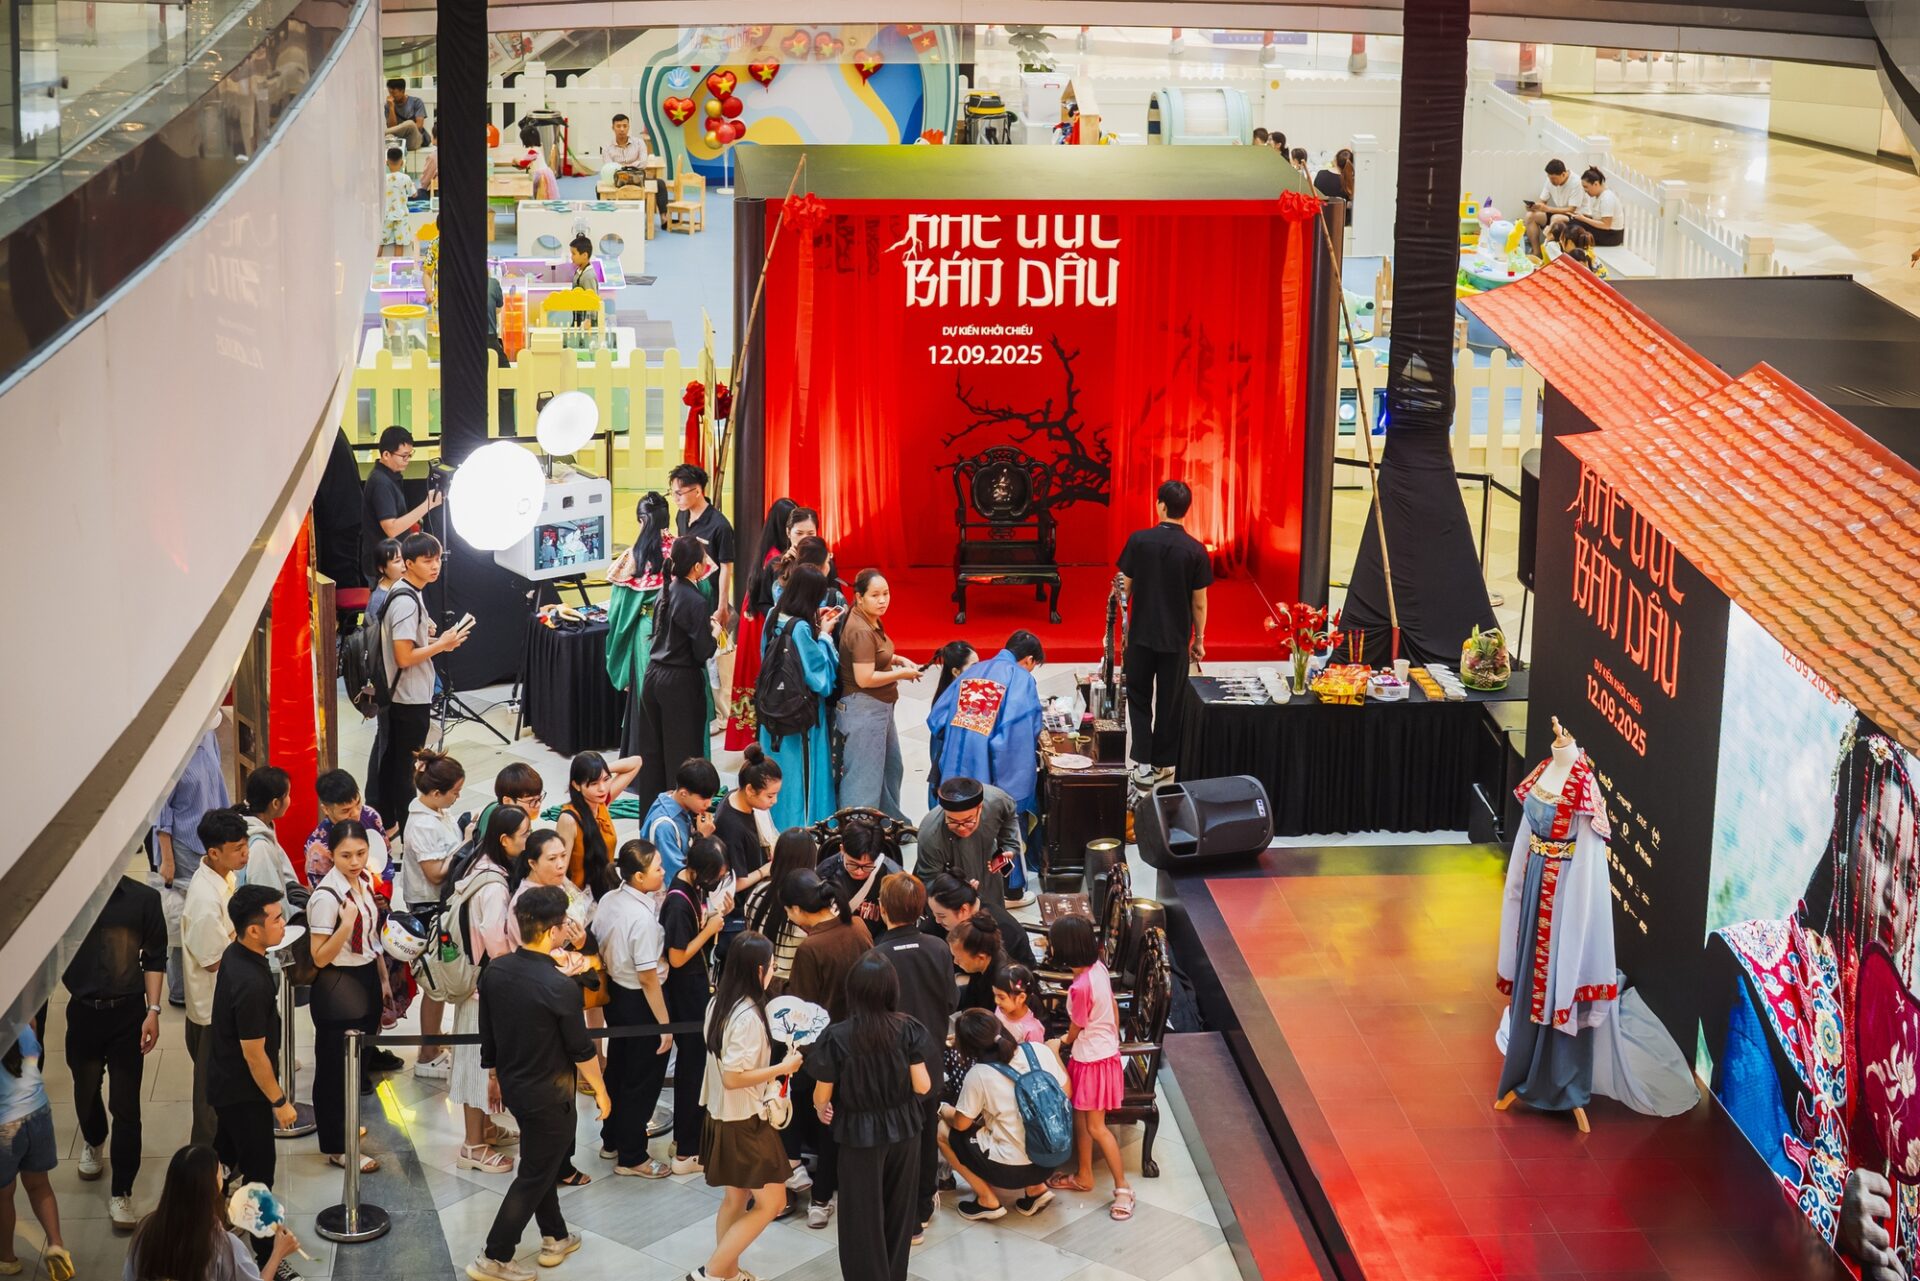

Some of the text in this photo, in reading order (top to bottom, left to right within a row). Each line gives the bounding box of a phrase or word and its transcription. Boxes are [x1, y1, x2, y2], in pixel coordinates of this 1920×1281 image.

[902, 250, 1120, 308] BÁN DÂU
[928, 344, 1043, 365] 12.09.2025
[942, 325, 958, 338] DỰ
[958, 323, 980, 337] KIẾN
[1005, 323, 1034, 337] CHIẾU
[1573, 531, 1681, 699] BÁN DÂU
[1587, 674, 1647, 757] 12.09.2025
